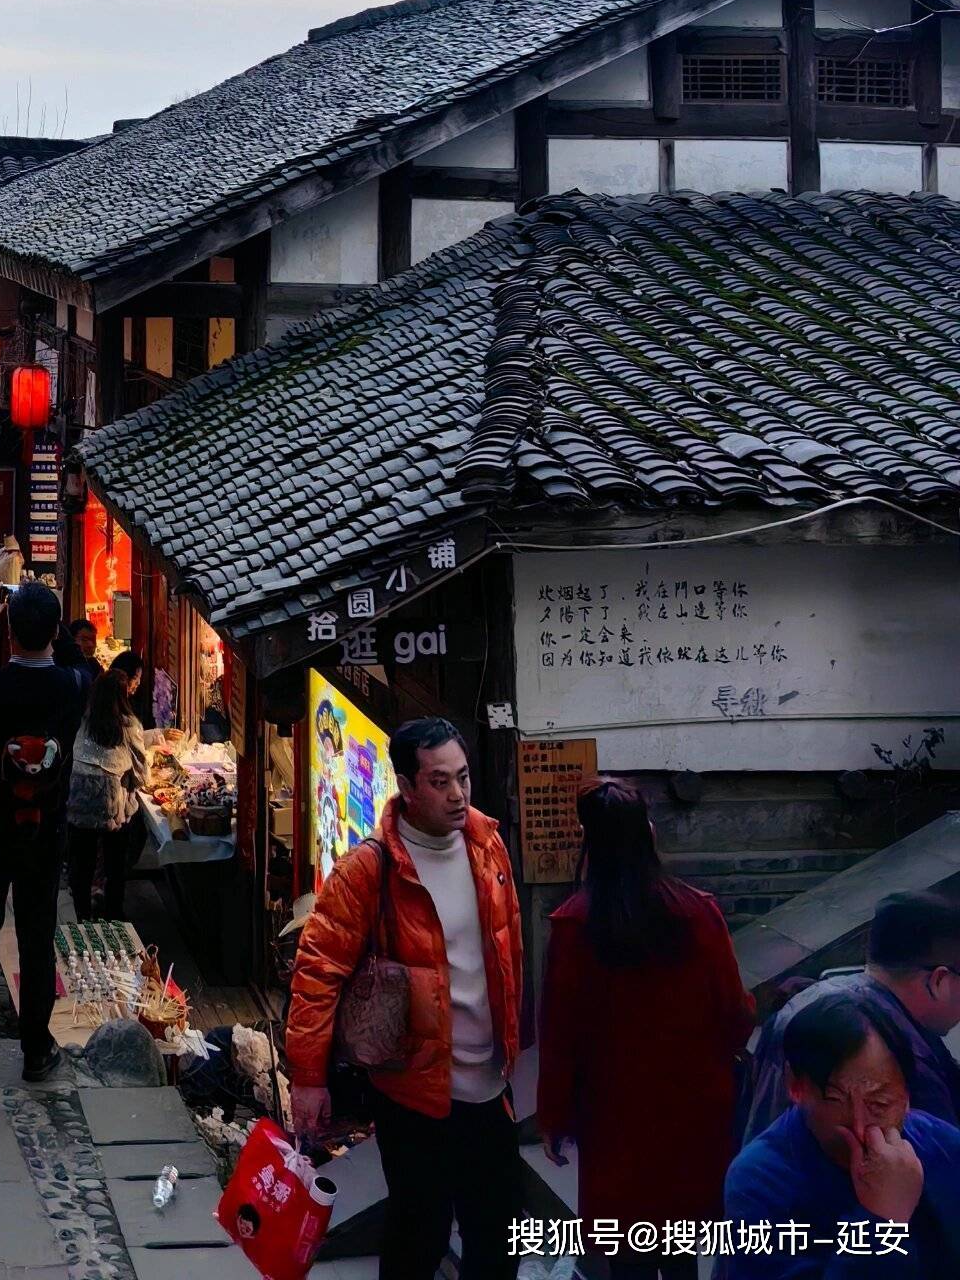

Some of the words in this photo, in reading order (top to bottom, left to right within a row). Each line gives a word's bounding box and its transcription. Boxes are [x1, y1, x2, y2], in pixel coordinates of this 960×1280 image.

[307, 538, 456, 641] 拾圆小铺
[339, 626, 378, 665] 逛
[393, 623, 449, 665] gai
